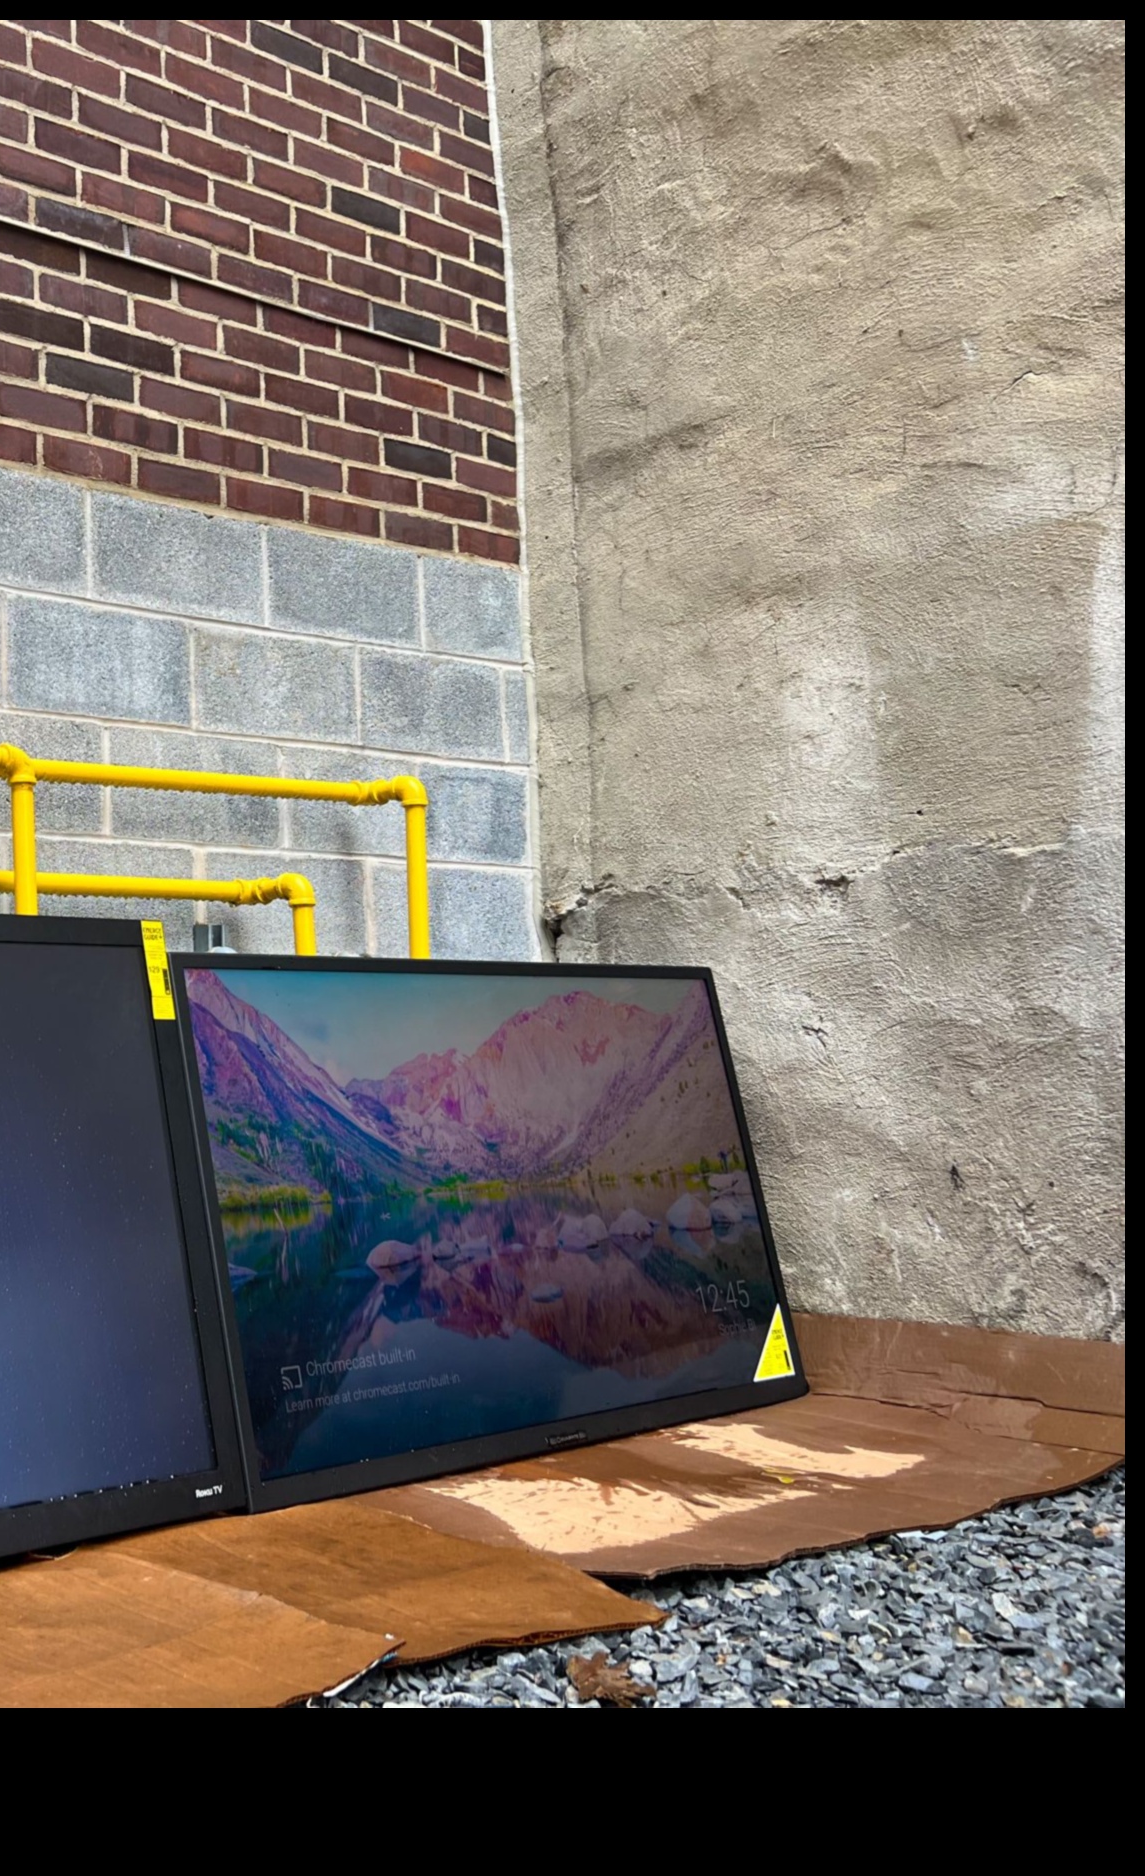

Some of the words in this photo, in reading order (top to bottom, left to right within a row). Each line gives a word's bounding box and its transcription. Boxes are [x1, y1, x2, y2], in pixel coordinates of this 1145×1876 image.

[695, 1279, 751, 1314] 12:45
[305, 1353, 377, 1377] Chromecast
[378, 1346, 416, 1367] built-in
[284, 1398, 314, 1413] Learn
[315, 1394, 340, 1409] more
[342, 1391, 352, 1404] at
[353, 1371, 461, 1401] chromecast.com/built-in
[213, 1484, 223, 1495] TV
